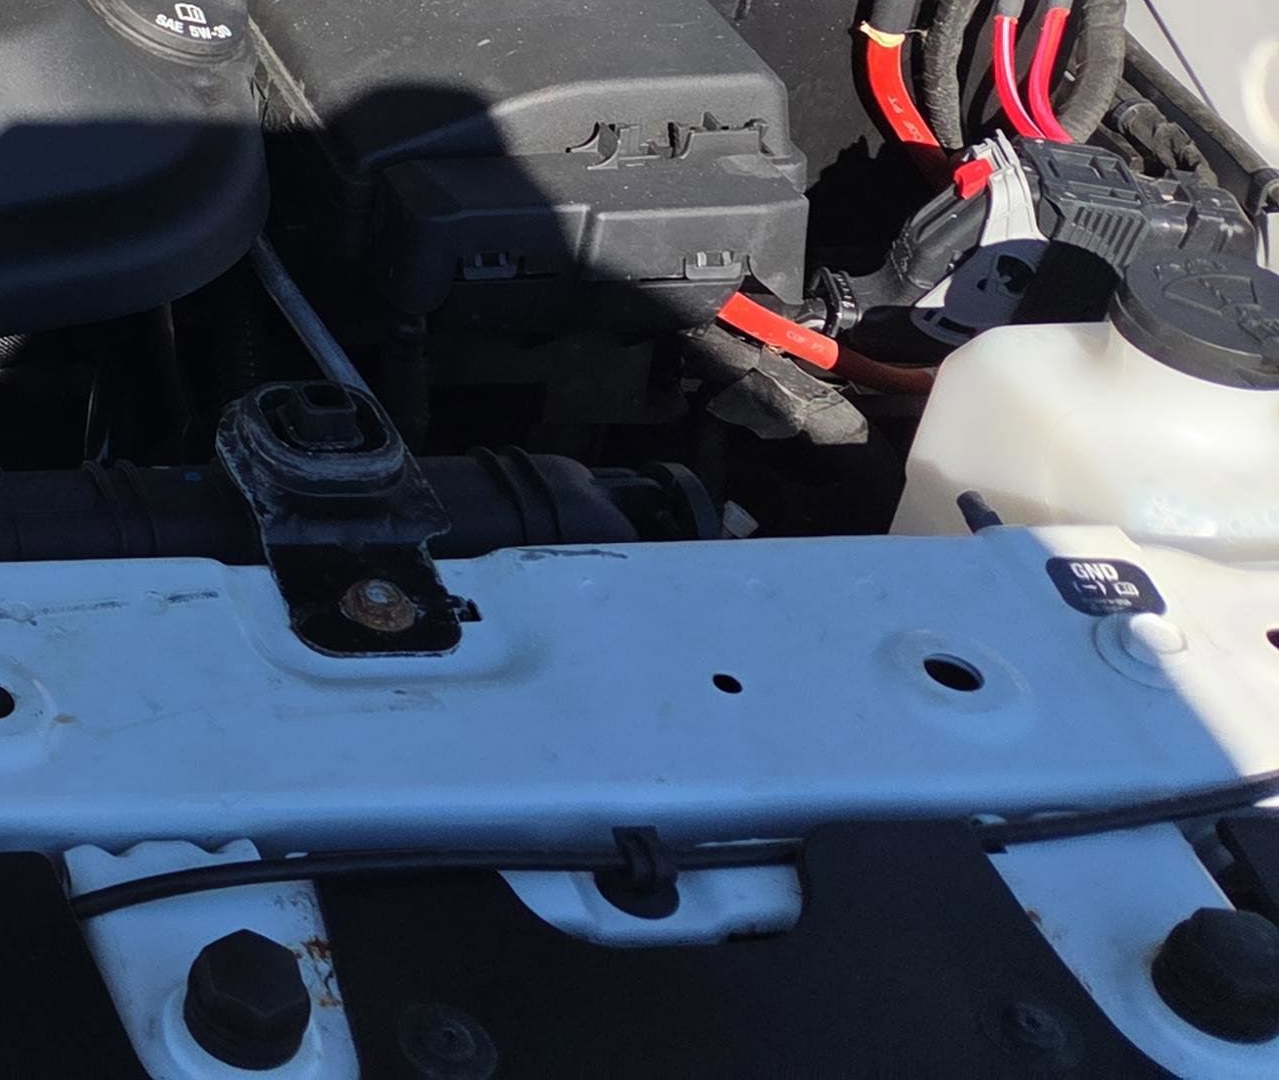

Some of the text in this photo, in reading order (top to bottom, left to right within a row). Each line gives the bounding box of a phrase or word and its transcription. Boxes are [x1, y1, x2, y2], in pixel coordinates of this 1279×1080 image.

[155, 13, 233, 40] SAE 5W-30
[1069, 562, 1119, 582] GND
